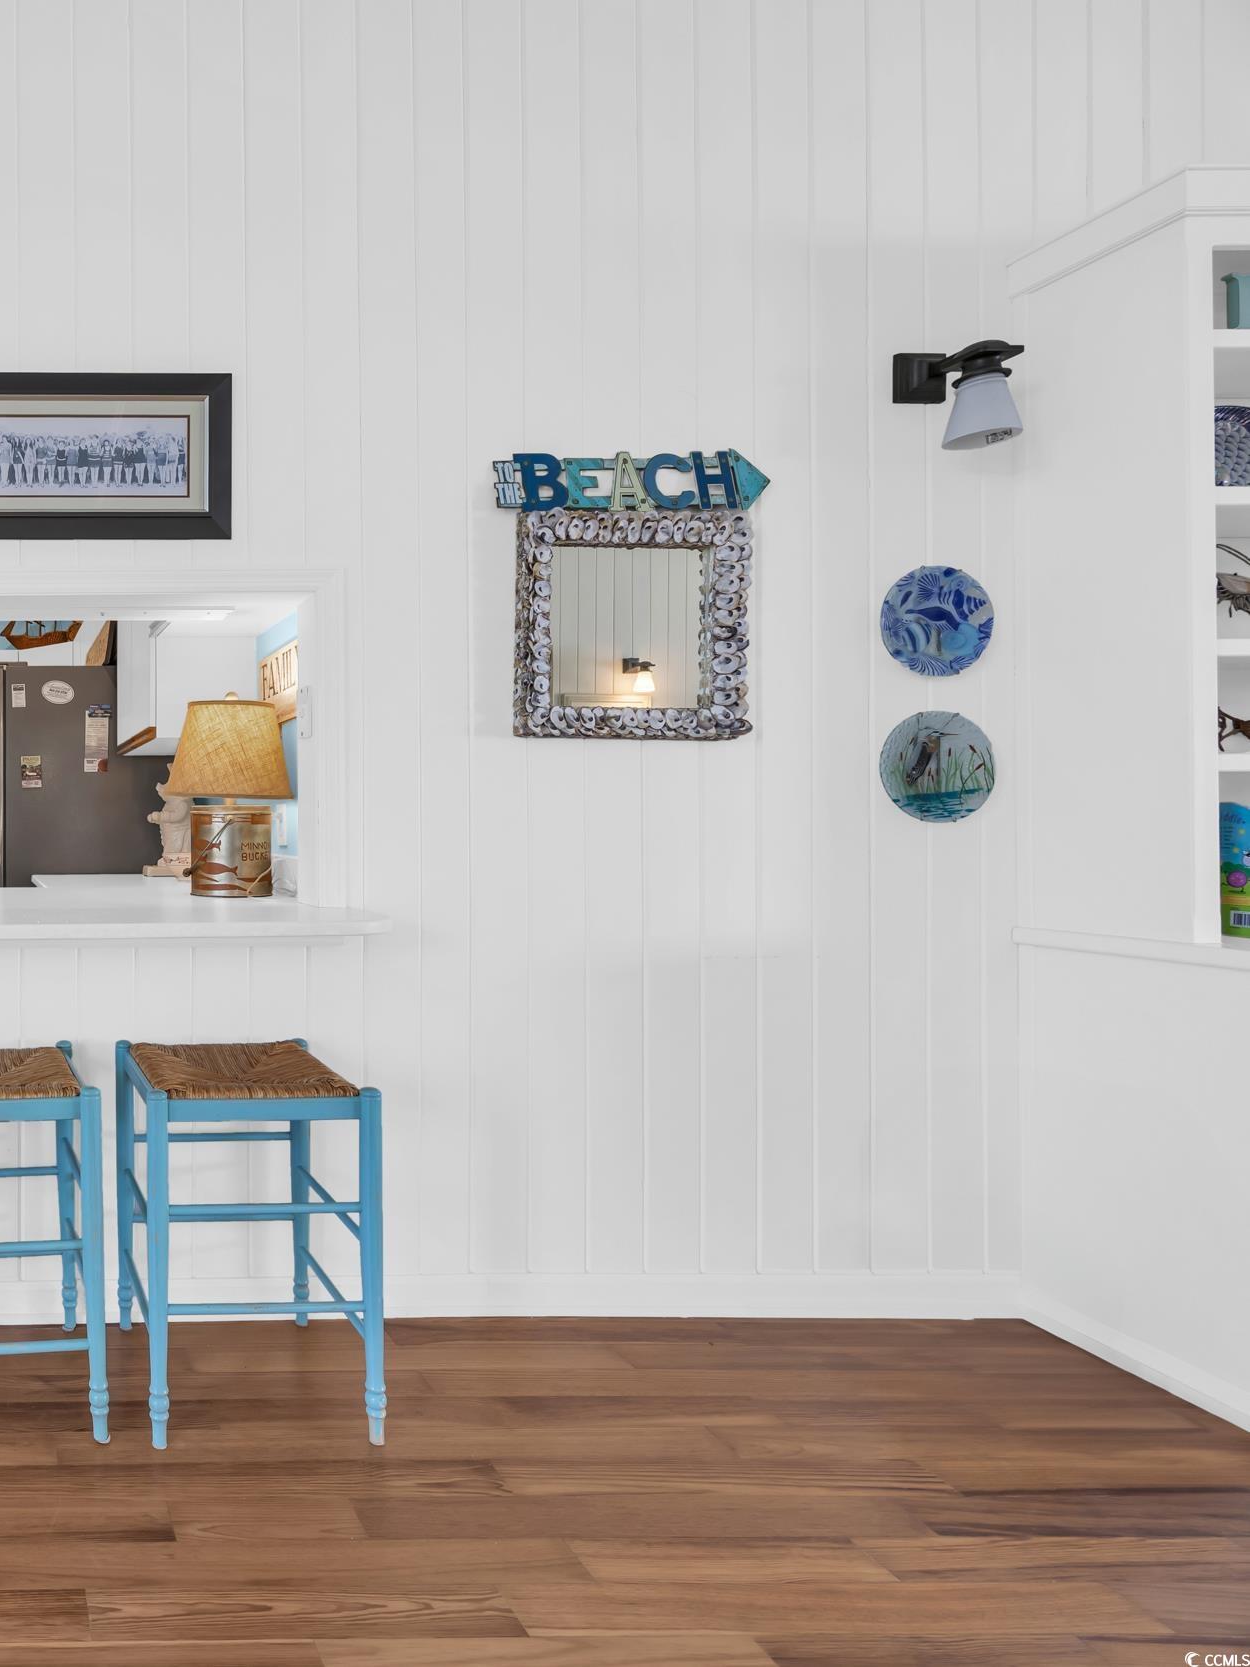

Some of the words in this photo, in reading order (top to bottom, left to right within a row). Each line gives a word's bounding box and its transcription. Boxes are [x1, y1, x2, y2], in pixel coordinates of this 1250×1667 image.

[493, 461, 515, 483] TO
[512, 451, 737, 512] BEACH
[495, 483, 524, 505] THE
